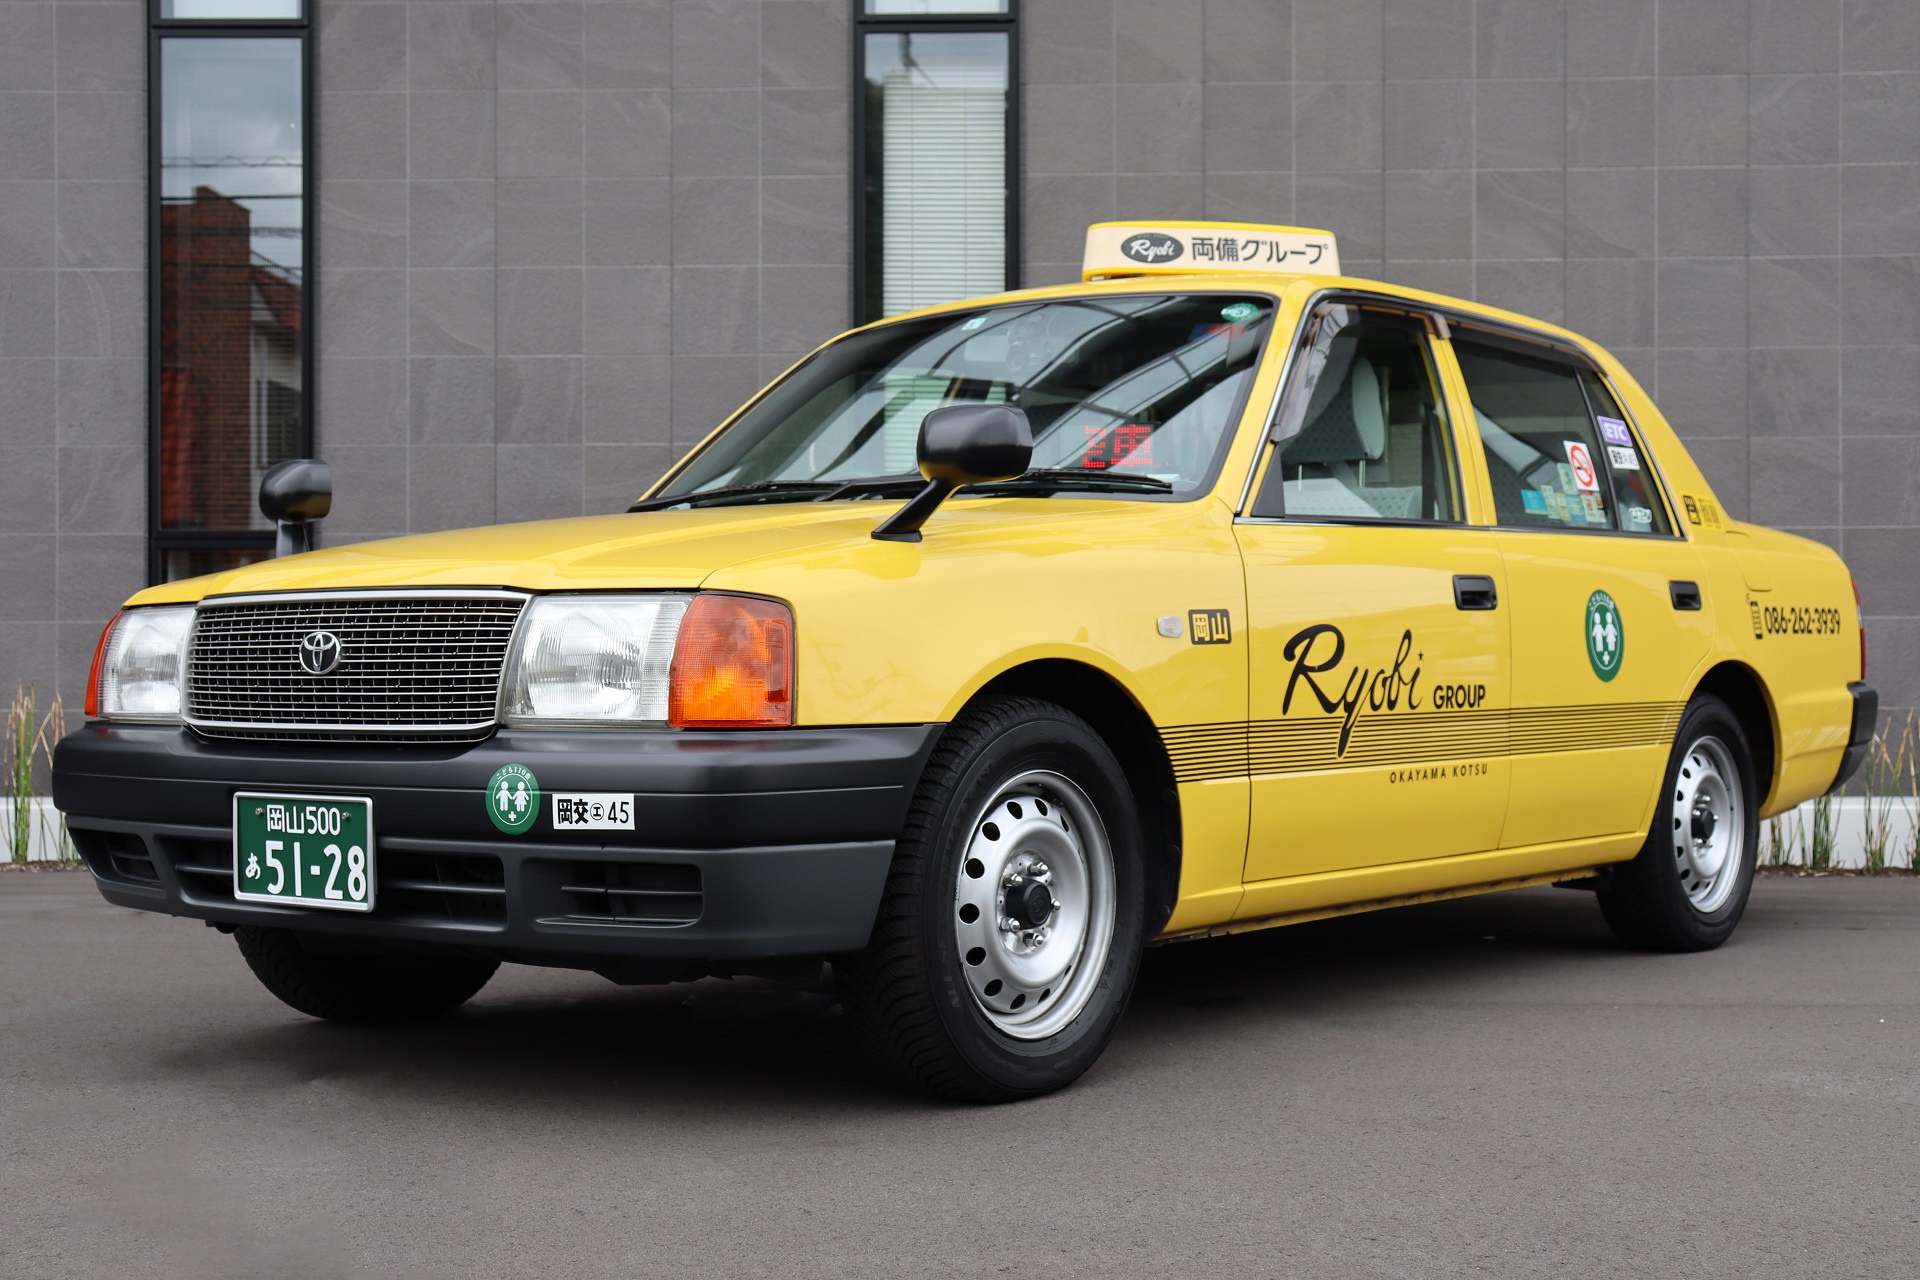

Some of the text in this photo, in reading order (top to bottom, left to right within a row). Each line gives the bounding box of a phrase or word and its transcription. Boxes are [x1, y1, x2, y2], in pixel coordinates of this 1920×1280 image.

[1130, 239, 1175, 262] Ryobi
[1191, 236, 1329, 264] 両備グループ
[1603, 421, 1628, 442] ETC
[1191, 612, 1229, 642] 岡山
[1282, 623, 1486, 758] Ryobi GROUP
[1389, 763, 1488, 784] OKAYAMA KOTSU
[266, 804, 340, 836] 岡山500
[265, 840, 366, 901] 51-28
